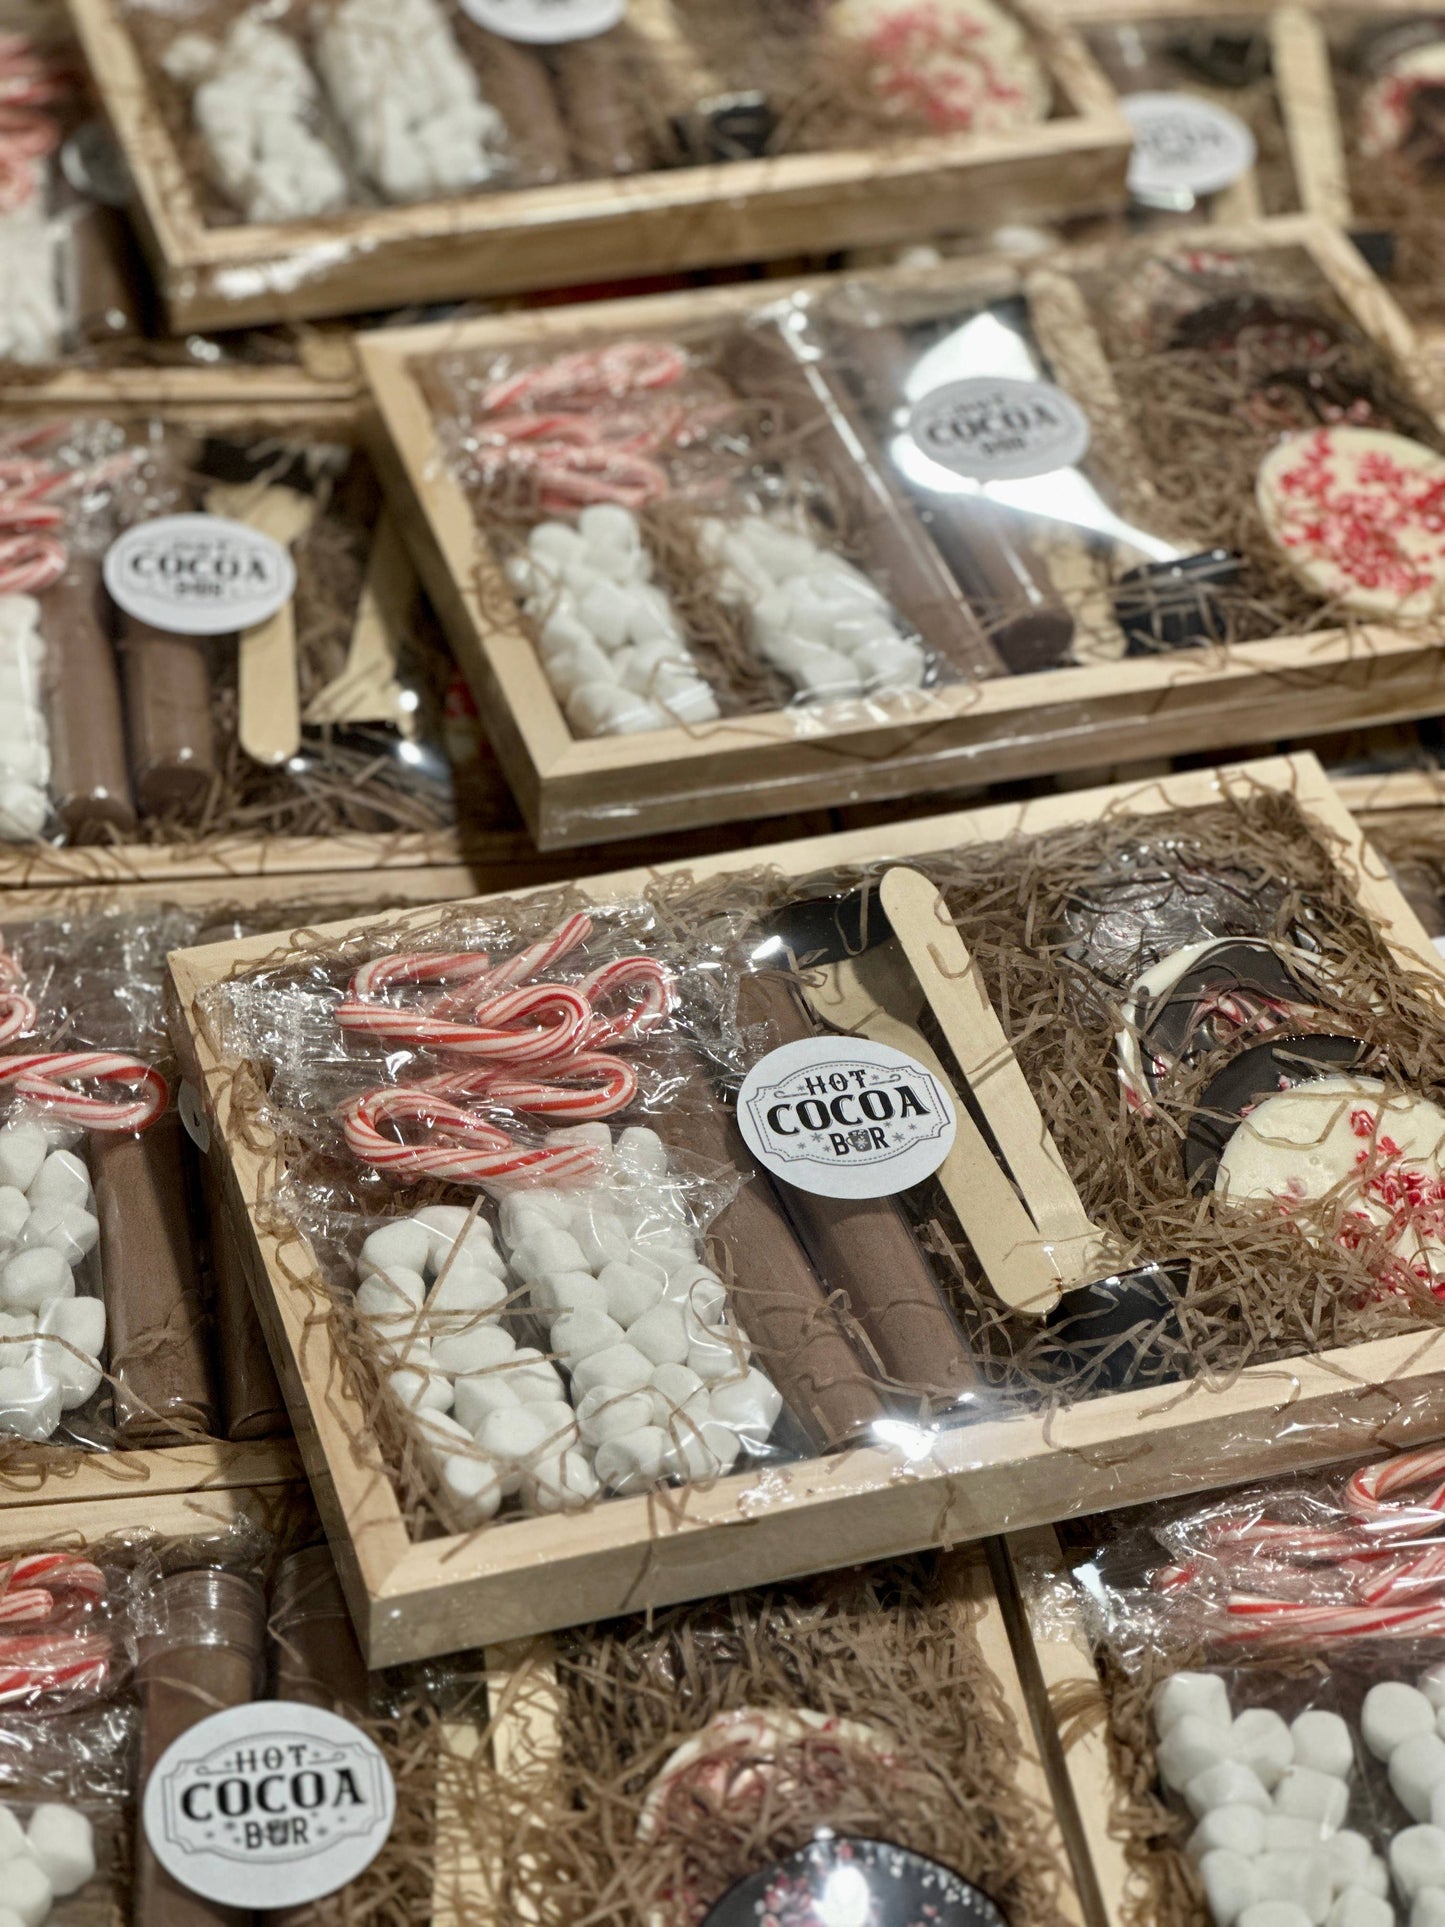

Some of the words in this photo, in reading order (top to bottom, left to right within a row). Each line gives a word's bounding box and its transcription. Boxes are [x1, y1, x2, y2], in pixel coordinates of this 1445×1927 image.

[804, 1069, 866, 1096] HOT
[766, 1085, 931, 1136] COCOA
[828, 1126, 890, 1156] BR
[234, 1744, 308, 1773] HOT
[180, 1767, 366, 1822] COCOA
[244, 1816, 310, 1850] BR
